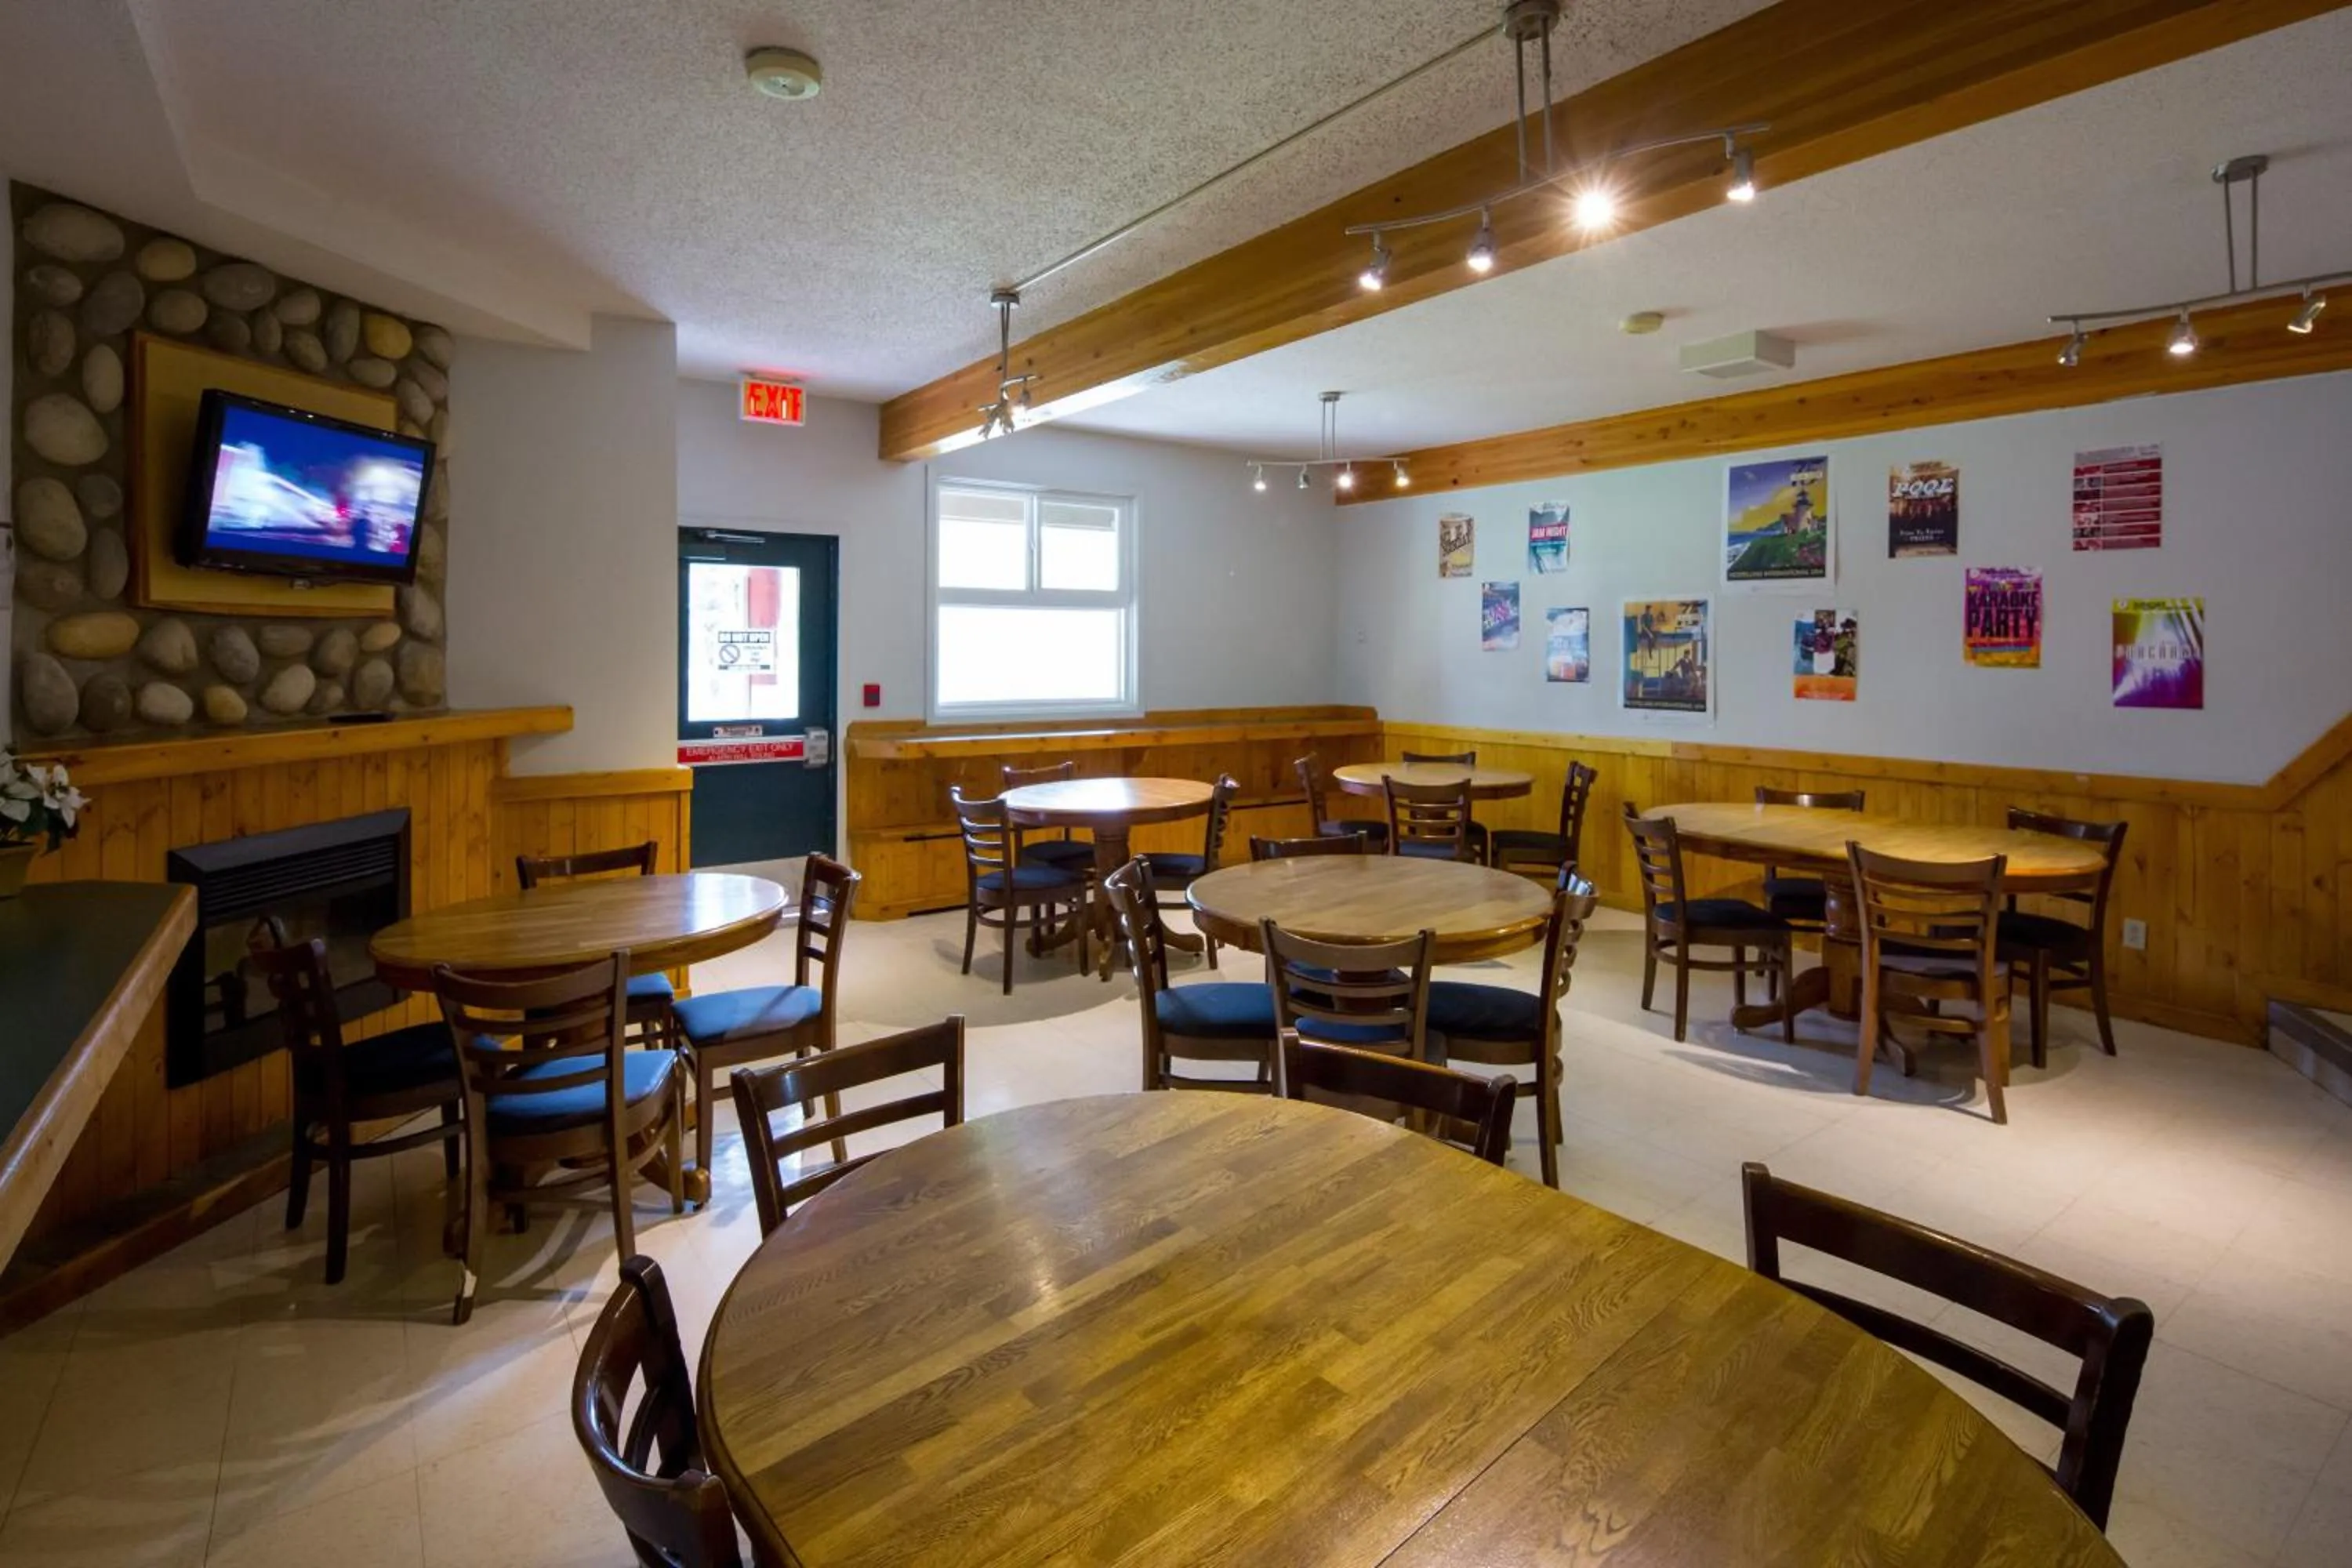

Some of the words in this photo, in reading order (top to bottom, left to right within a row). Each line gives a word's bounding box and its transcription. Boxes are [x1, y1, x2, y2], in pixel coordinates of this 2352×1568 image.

[749, 383, 802, 421] EXIT
[1892, 477, 1954, 497] POOL
[1967, 591, 2038, 609] KARAOKE
[1967, 609, 2038, 637] PARTY
[686, 746, 746, 757] EMERGENCY
[749, 744, 768, 753] EXIT
[770, 742, 793, 752] ONLY
